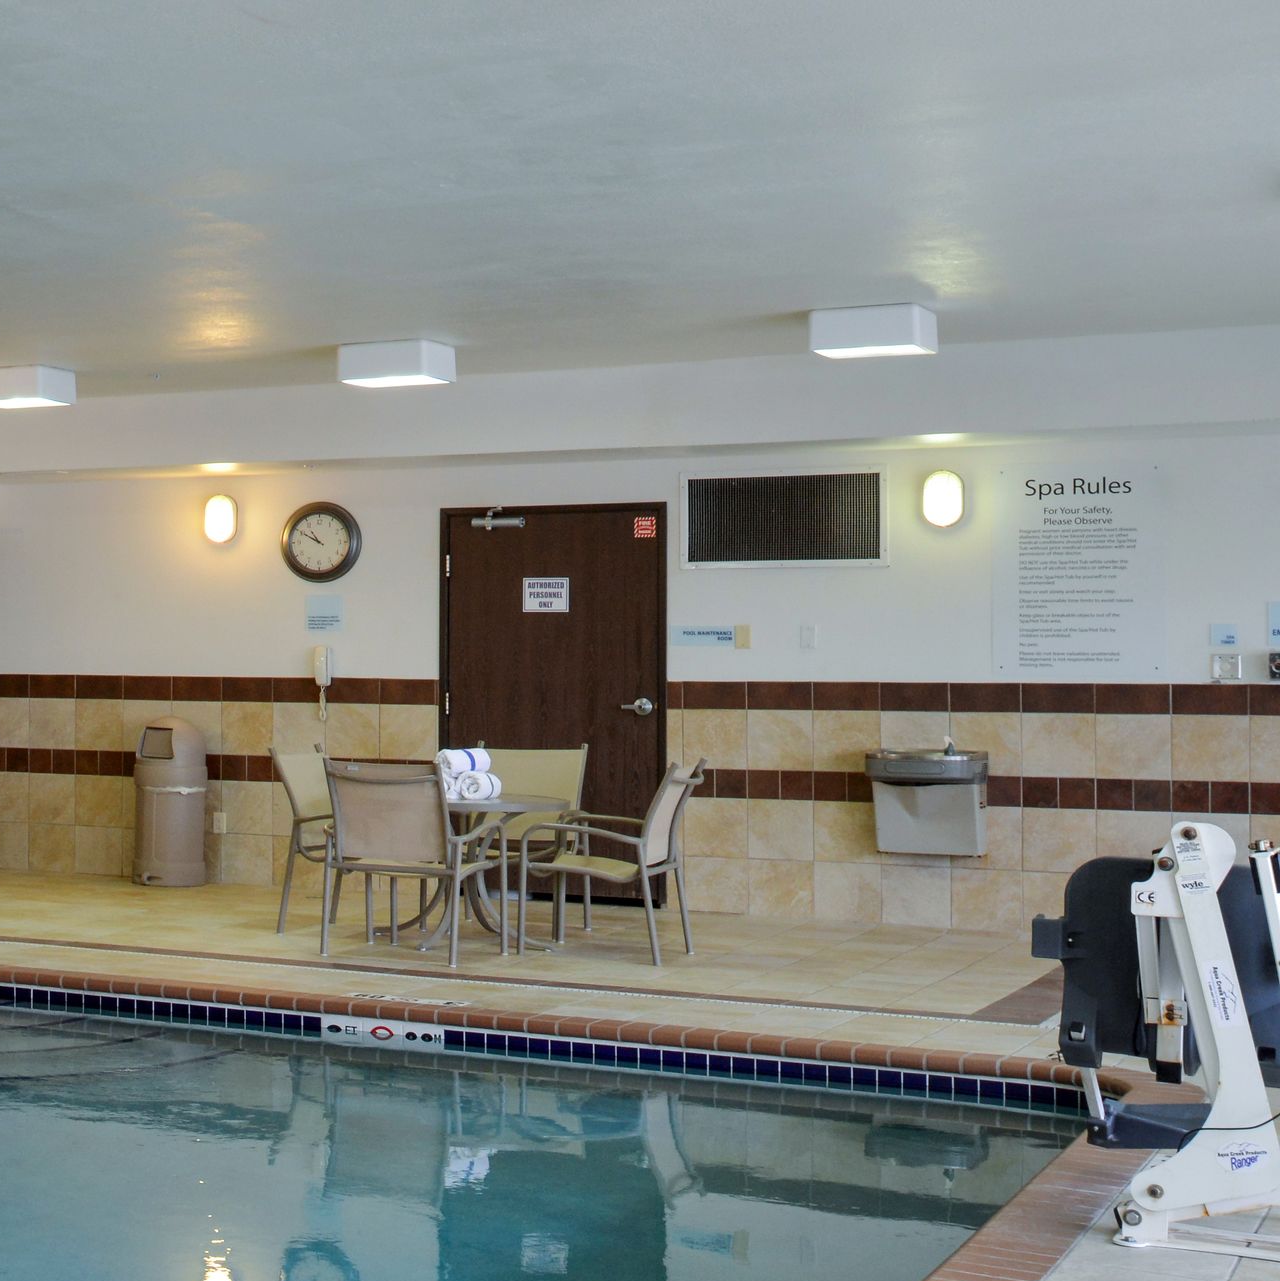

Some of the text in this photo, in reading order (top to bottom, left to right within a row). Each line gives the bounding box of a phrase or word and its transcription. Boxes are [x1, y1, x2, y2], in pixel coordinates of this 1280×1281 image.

[1025, 476, 1132, 500] Spa Rules
[1060, 506, 1080, 514] Your
[1074, 517, 1113, 525] Observe
[527, 582, 565, 590] AUTHORIZED
[538, 601, 553, 609] ONLY
[1180, 880, 1204, 890] wyle
[1230, 1155, 1259, 1171] Ranger
